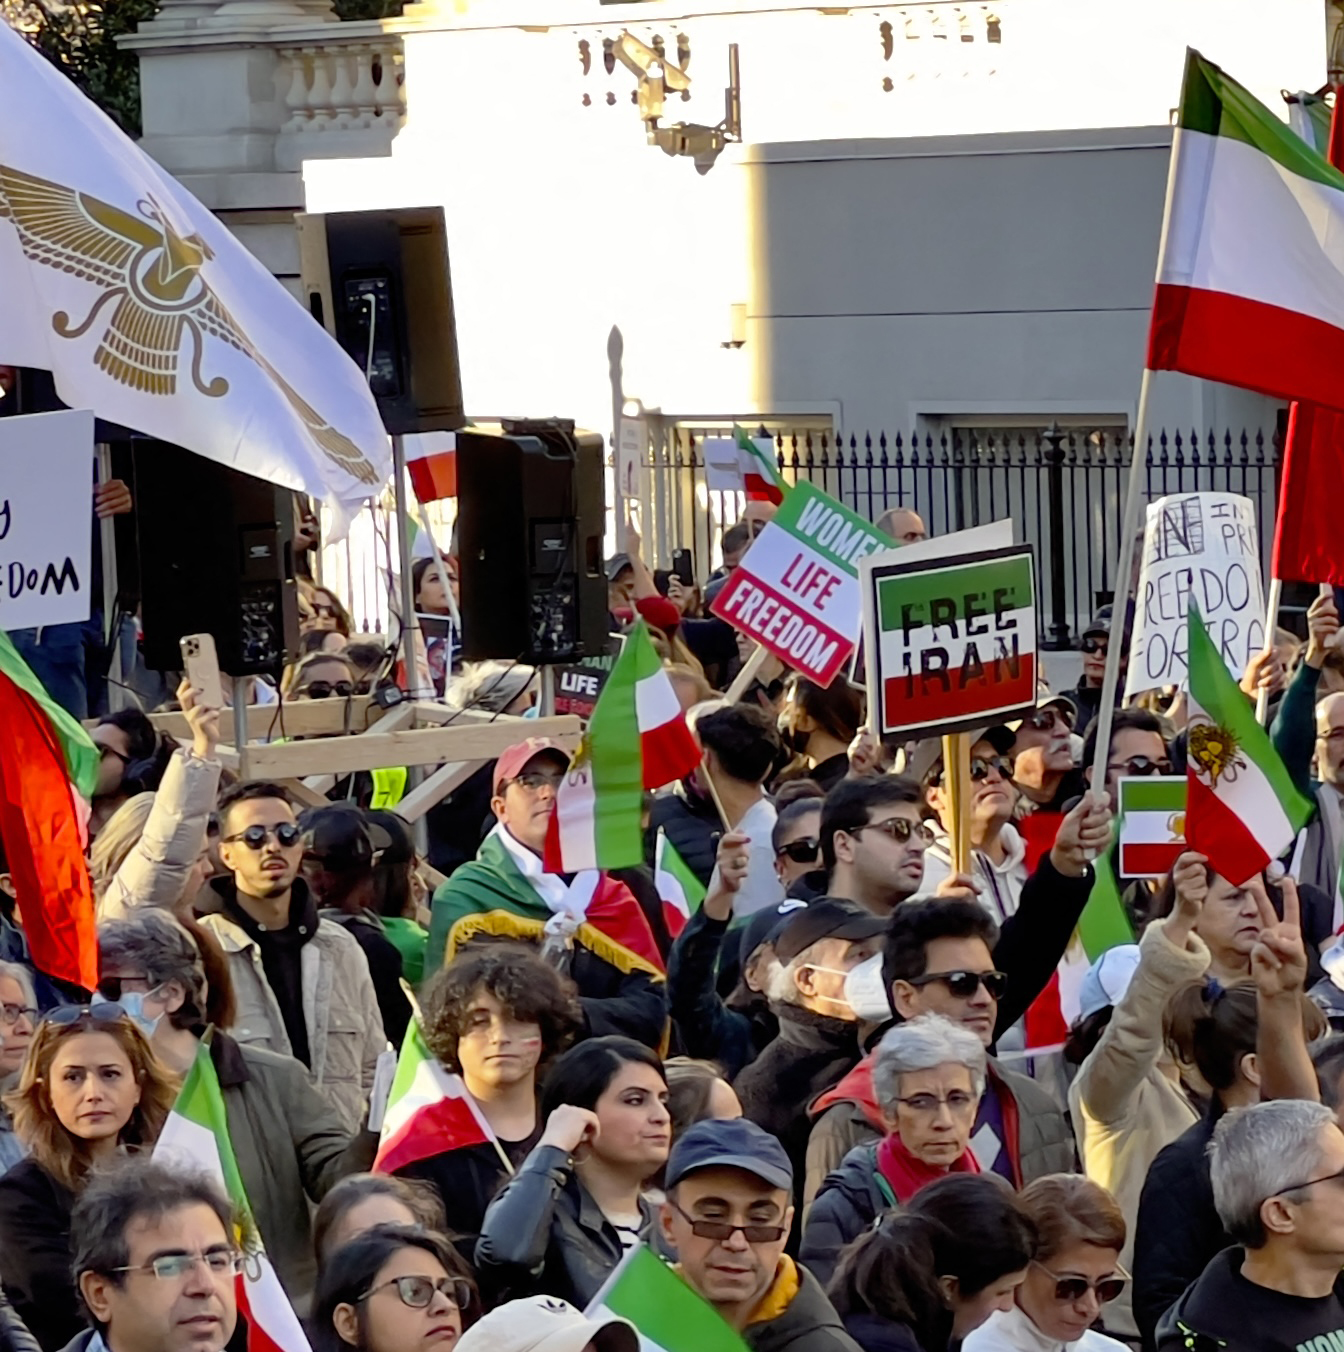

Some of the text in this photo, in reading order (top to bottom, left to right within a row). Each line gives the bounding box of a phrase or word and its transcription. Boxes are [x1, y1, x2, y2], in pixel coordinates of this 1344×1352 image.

[780, 553, 842, 611] LIFE
[724, 580, 839, 674] FREEDOM
[901, 587, 1017, 647] FREE
[560, 672, 599, 696] LIFE
[903, 633, 1019, 699] IRAN
